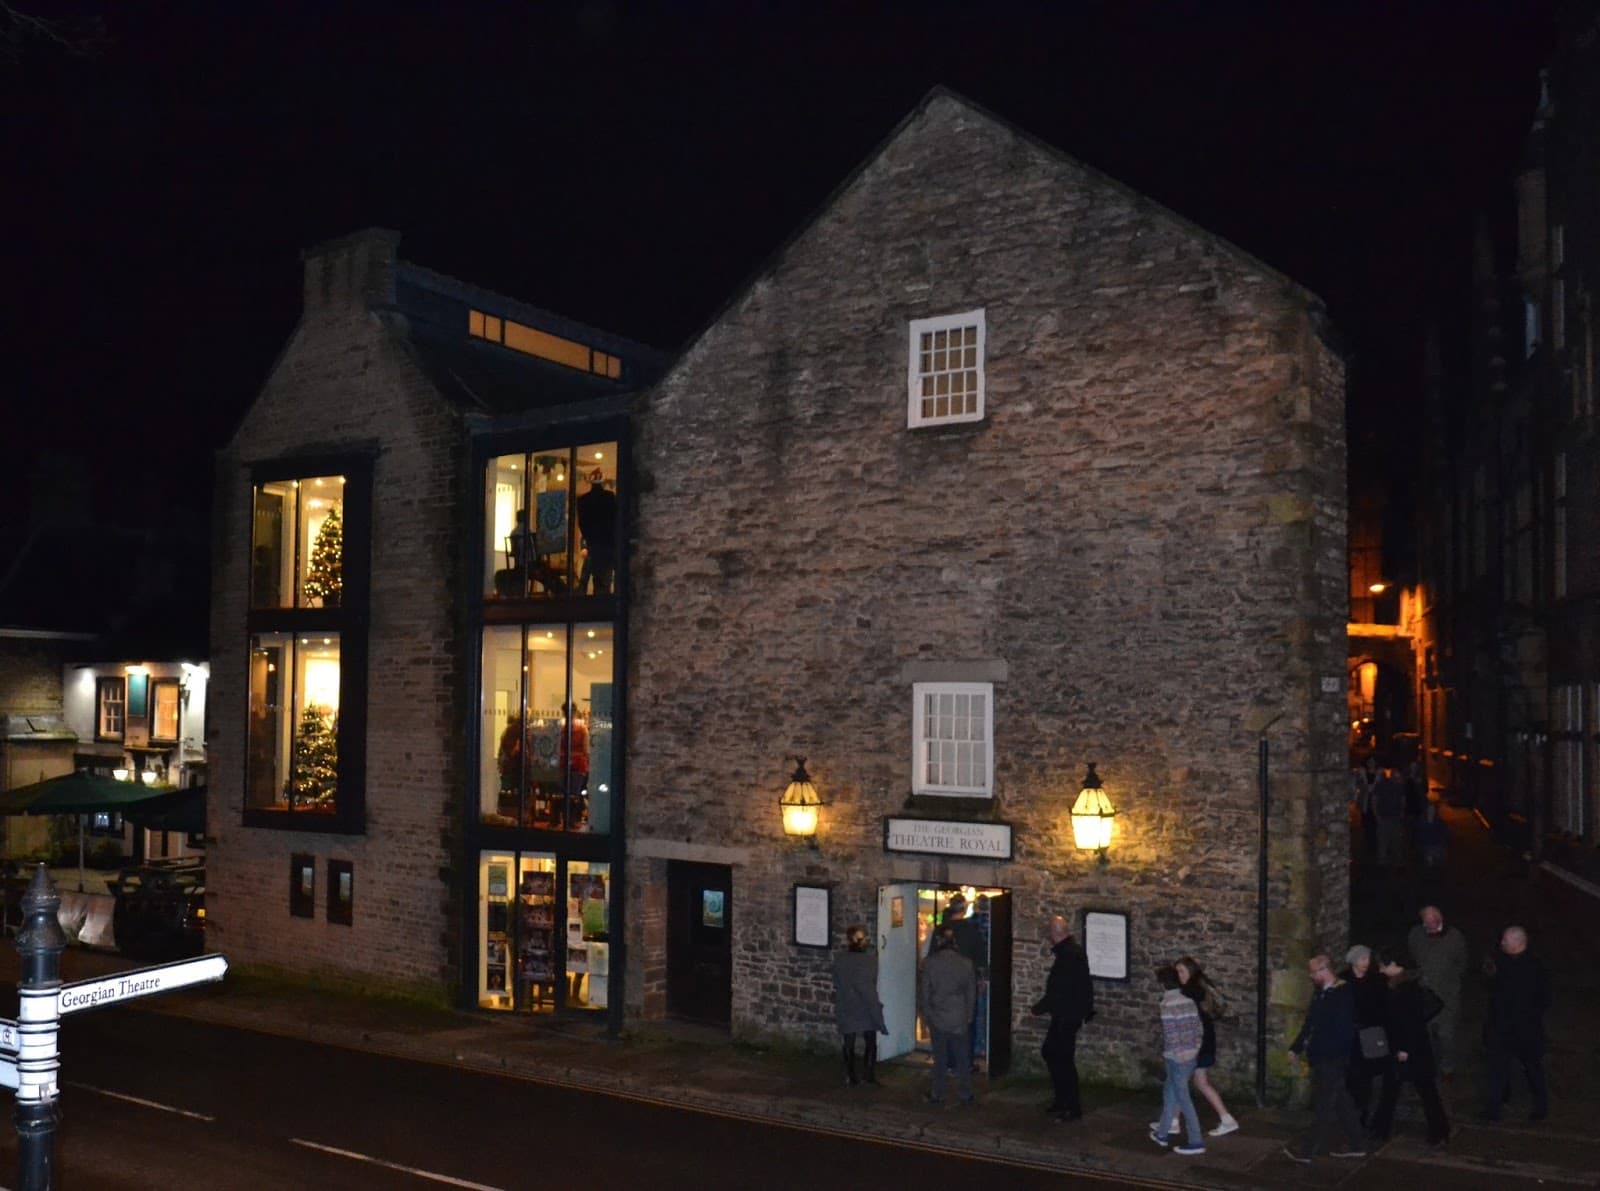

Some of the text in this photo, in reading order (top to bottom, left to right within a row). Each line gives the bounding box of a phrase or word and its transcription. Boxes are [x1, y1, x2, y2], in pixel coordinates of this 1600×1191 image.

[913, 823, 984, 836] THE GEORGIAN
[893, 834, 1005, 852] THEATRE ROYAL
[61, 977, 160, 1009] Georgian Theatre
